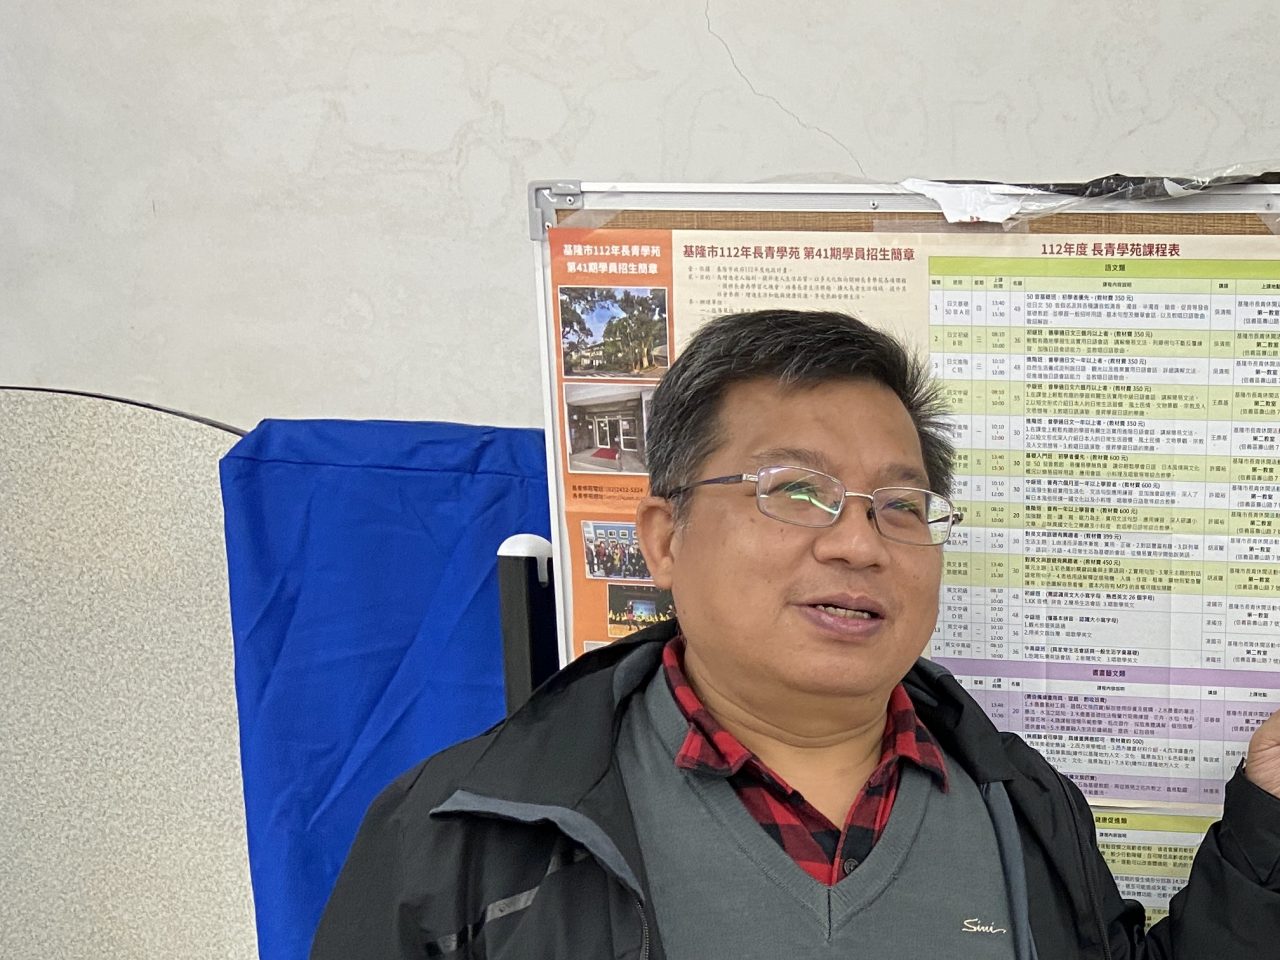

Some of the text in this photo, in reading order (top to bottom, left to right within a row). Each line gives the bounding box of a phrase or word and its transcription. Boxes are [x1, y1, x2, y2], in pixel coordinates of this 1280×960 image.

[563, 244, 661, 257] 基隆市112年長青學苑
[683, 245, 915, 261] 基隆市112年長青學苑 第41期學員招生簡章
[1041, 243, 1180, 257] 112年度 長青學苑課程表
[567, 261, 658, 274] 第41期學員招生簡章
[1105, 264, 1126, 272] 語文類
